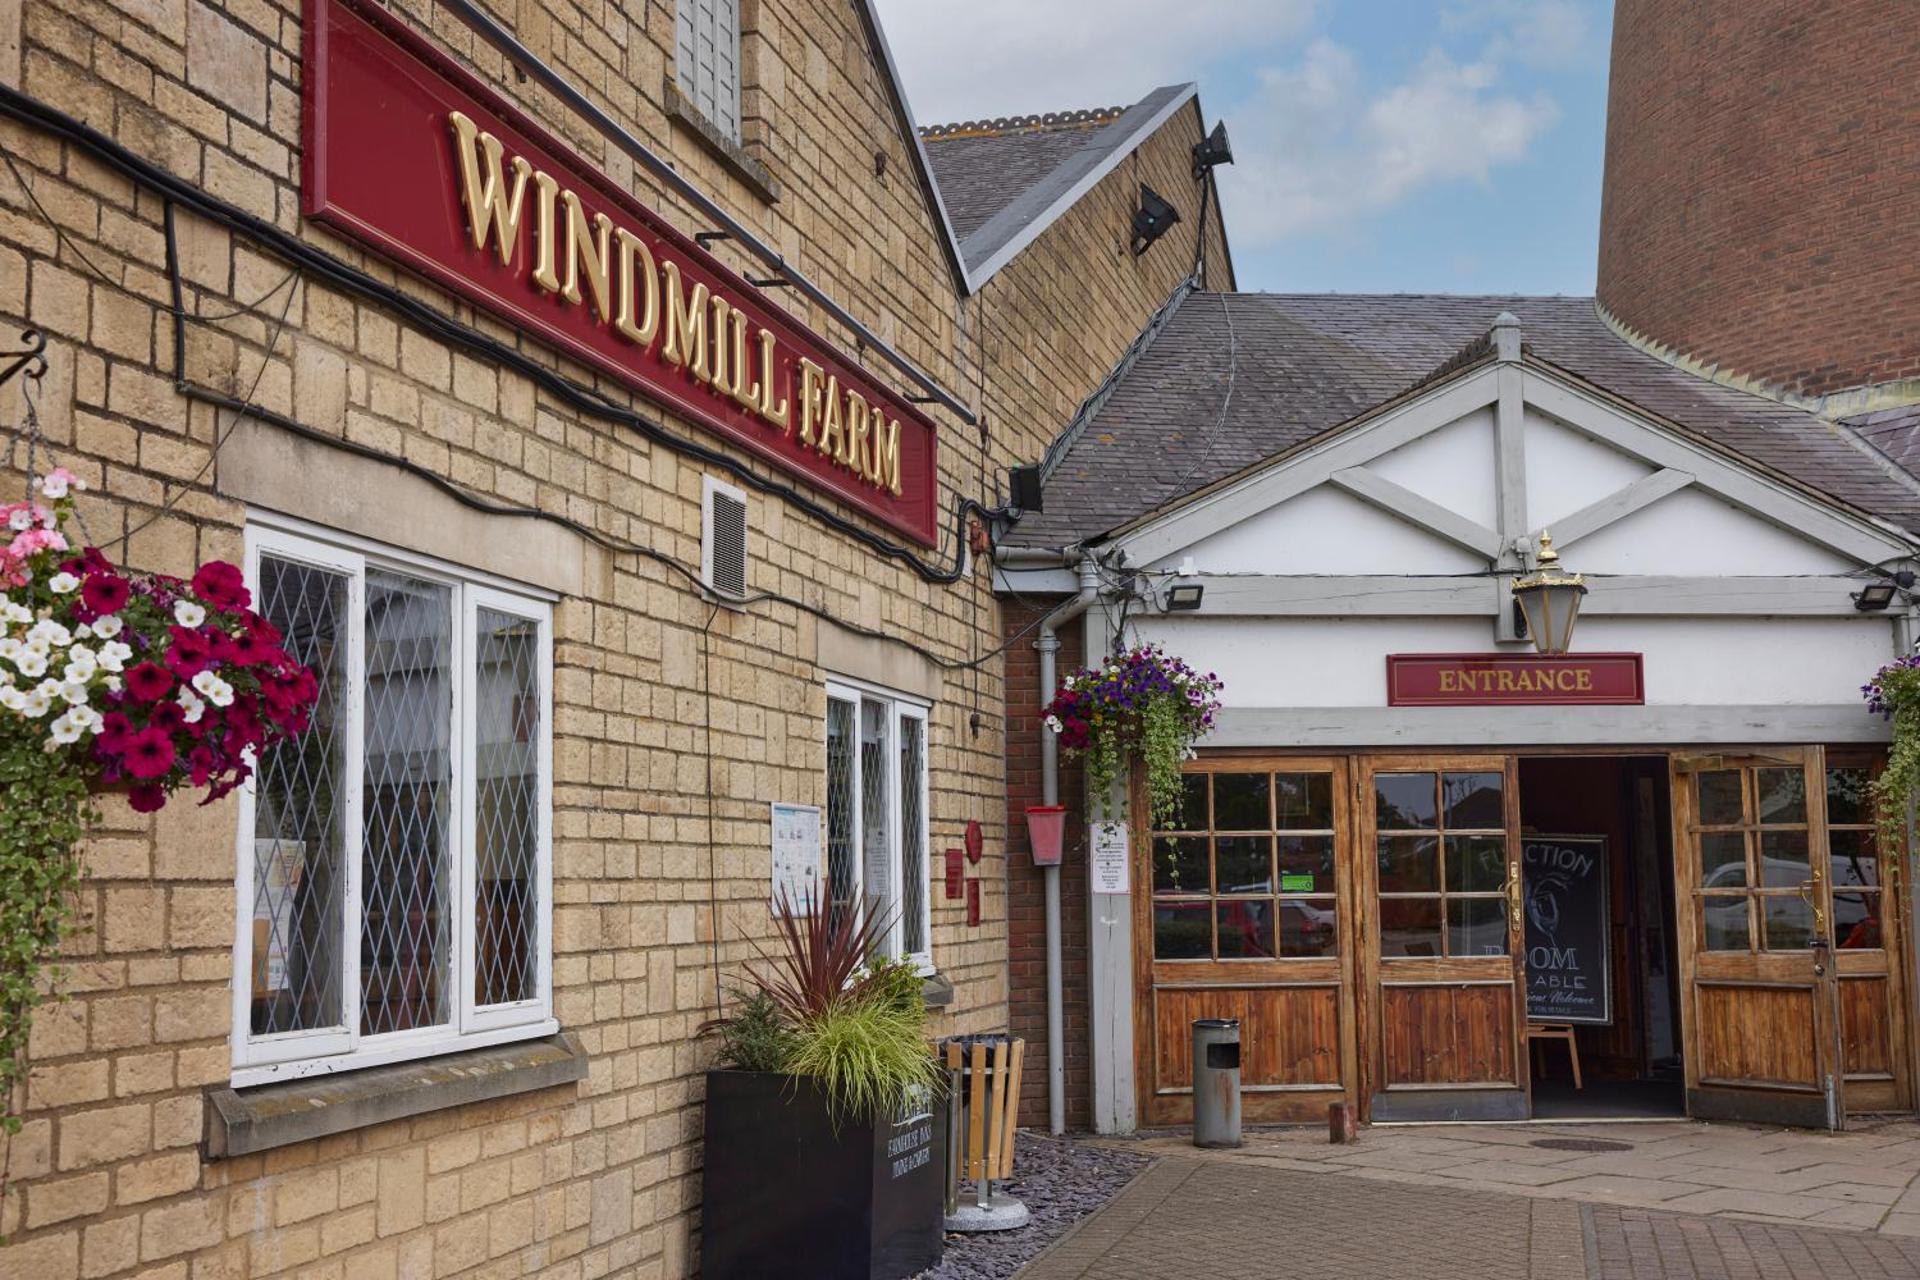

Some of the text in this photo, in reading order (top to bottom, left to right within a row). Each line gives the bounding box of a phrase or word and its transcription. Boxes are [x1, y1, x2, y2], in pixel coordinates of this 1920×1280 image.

[449, 110, 902, 496] WINDMILL FARM
[1439, 669, 1593, 692] ENTRANCE
[1480, 844, 1593, 876] FUCTION
